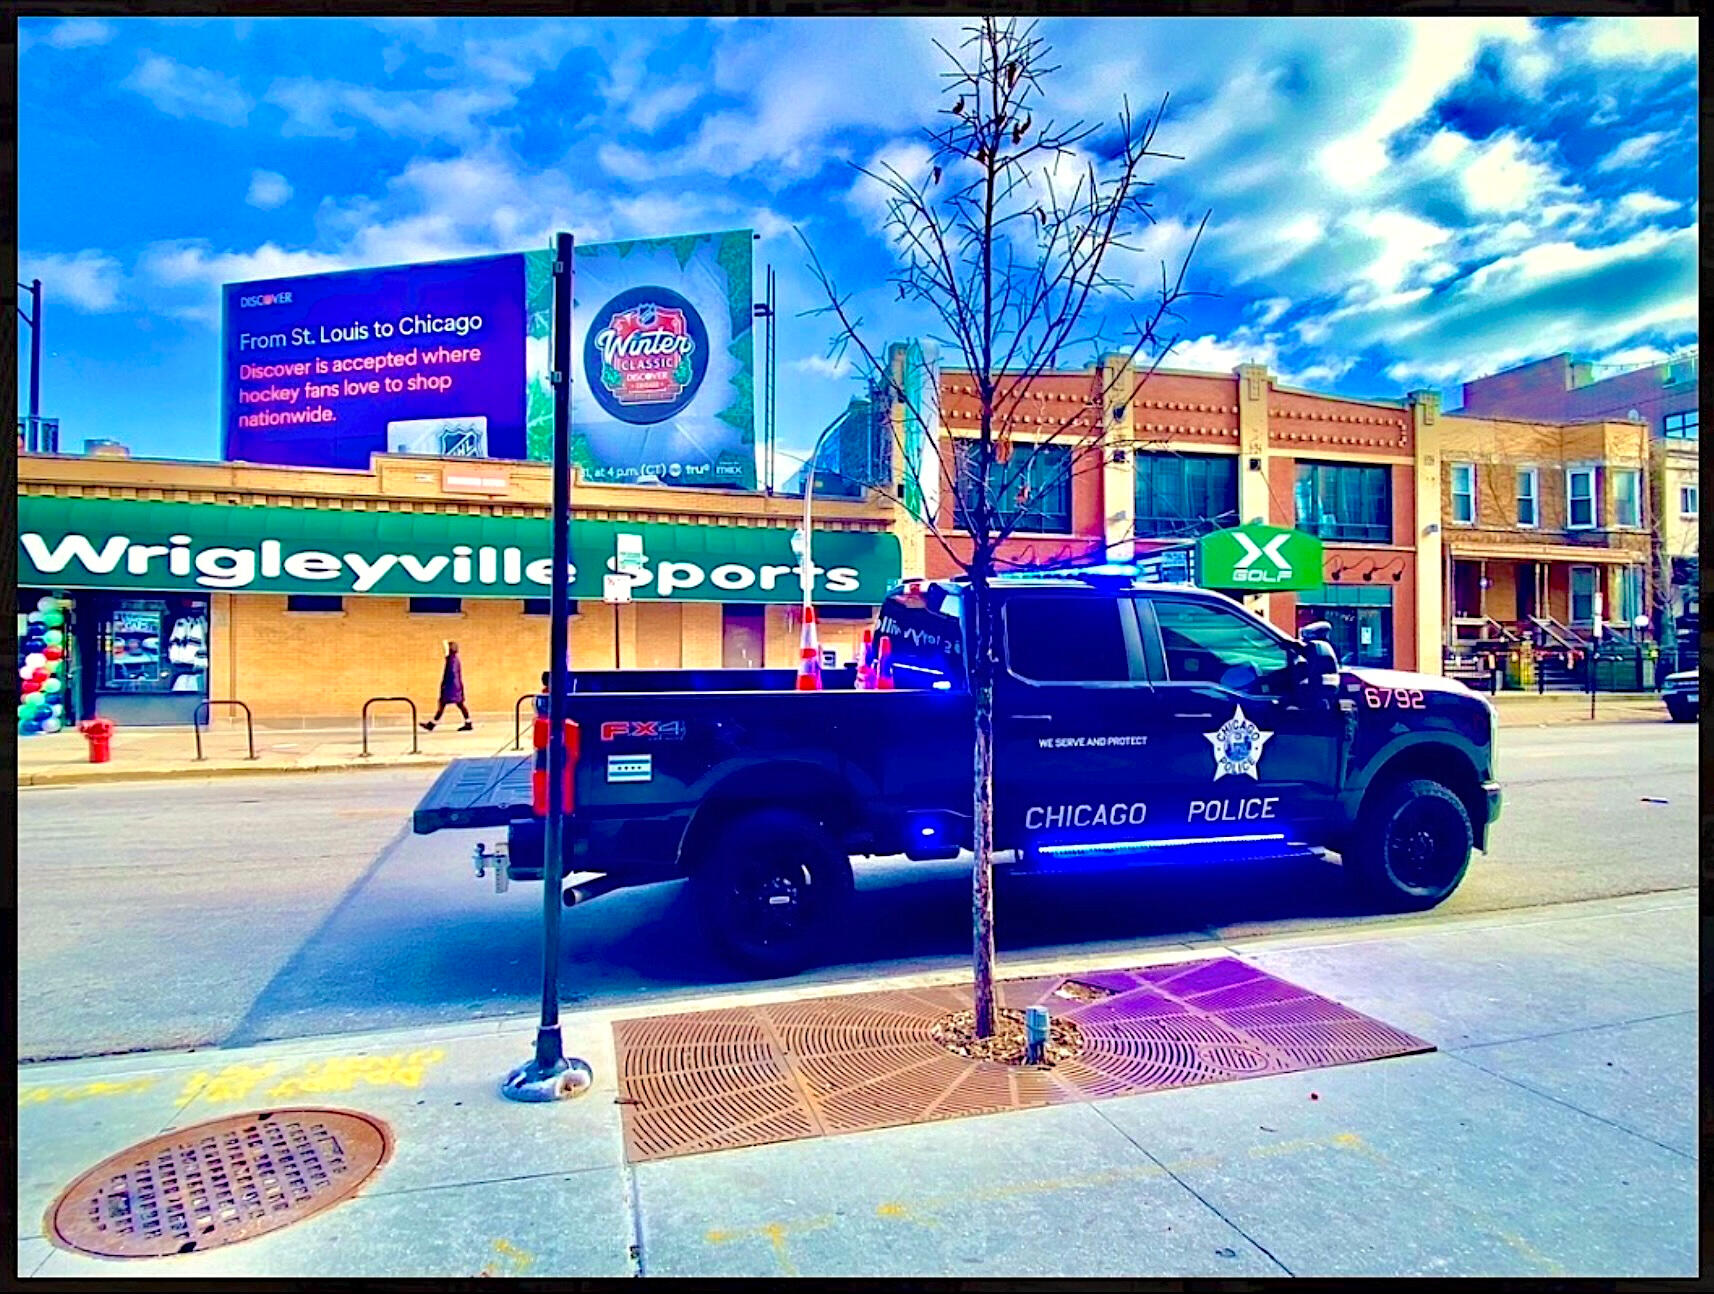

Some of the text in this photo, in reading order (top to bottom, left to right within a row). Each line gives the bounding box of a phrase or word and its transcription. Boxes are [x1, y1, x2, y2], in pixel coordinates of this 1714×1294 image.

[240, 291, 293, 308] DISCOVER
[240, 313, 483, 350] From St. Louis to Chicago
[597, 328, 692, 364] Winter
[240, 345, 481, 381] Discover is accepted where
[621, 359, 673, 371] CLASSIC
[239, 371, 452, 404] hockey fans love to shop
[626, 371, 668, 381] DISCOVER
[239, 405, 337, 428] nationwide.
[20, 532, 577, 592] Wrigleyville
[1231, 532, 1293, 570] X
[1232, 569, 1293, 583] GOLF
[1364, 687, 1427, 710] 6792
[601, 720, 685, 741] FX4
[1217, 719, 1260, 741] CHICAGO
[1039, 736, 1148, 748] WE SERVE AND PROTECT
[1220, 756, 1257, 775] POLICE
[1025, 797, 1279, 830] CHICAGO POLICE
